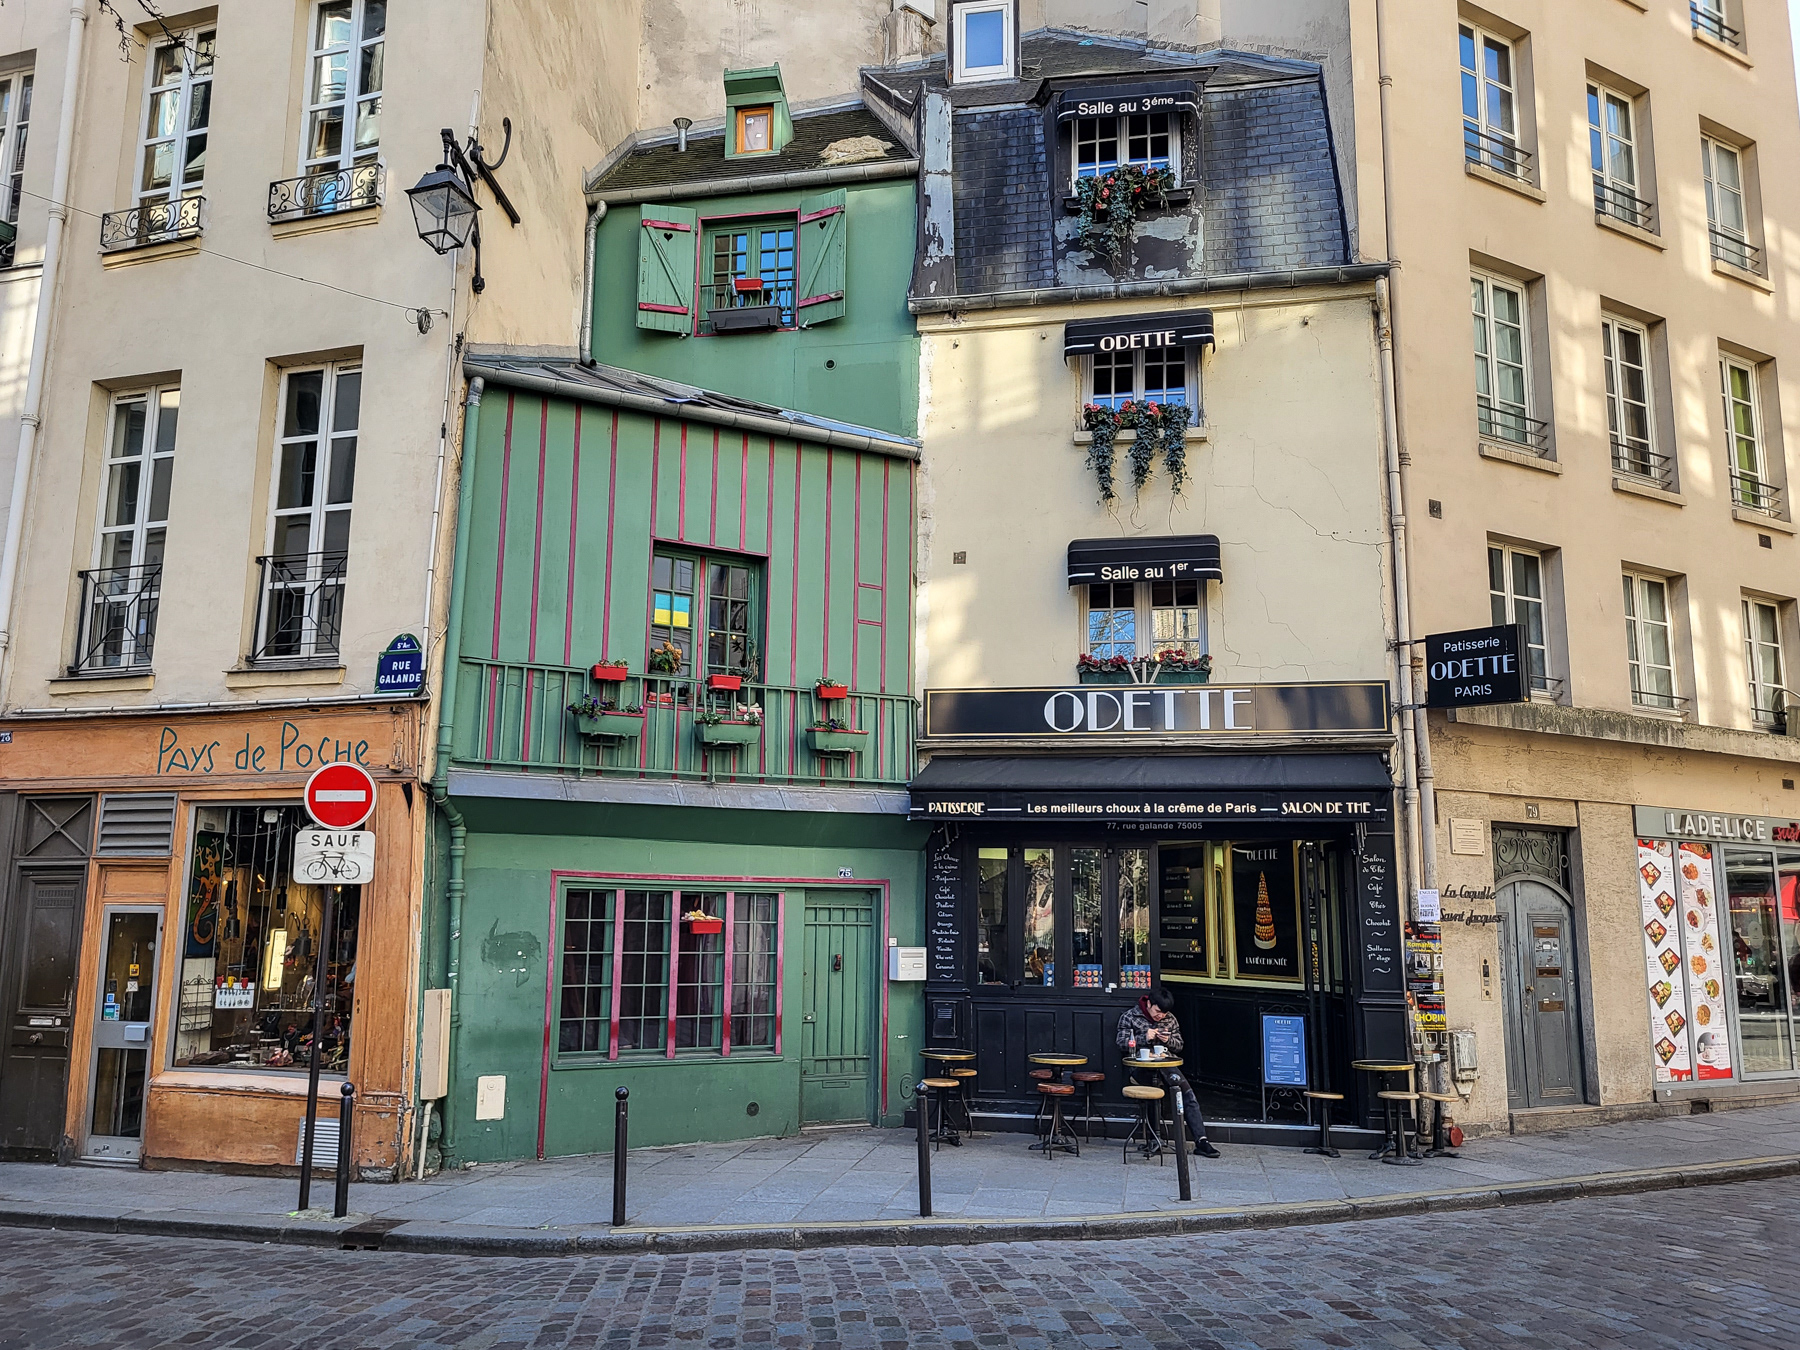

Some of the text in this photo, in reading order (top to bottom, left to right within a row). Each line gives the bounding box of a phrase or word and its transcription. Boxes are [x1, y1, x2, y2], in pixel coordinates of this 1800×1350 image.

[1078, 102, 1113, 115] Salle
[1119, 102, 1137, 113] au
[1100, 330, 1176, 351] ODETTE
[1101, 562, 1189, 580] Salle au 1er
[1443, 636, 1500, 653] Patisserie
[392, 661, 411, 671] RUE
[1430, 653, 1516, 680] ODETTE
[379, 673, 421, 684] GALANDE
[1454, 683, 1492, 697] PARIS
[1043, 689, 1253, 733] ODETTE
[235, 732, 266, 772] de
[928, 802, 985, 816] PATISSERIE
[1027, 803, 1048, 813] Les
[1050, 803, 1103, 813] meilleurs
[1106, 803, 1141, 813] choux
[1143, 802, 1151, 813] à
[1154, 803, 1165, 813] la
[1207, 803, 1222, 813] de
[1225, 803, 1257, 813] Paris
[1281, 802, 1323, 815] SALON
[1326, 802, 1343, 813] DE
[1527, 806, 1538, 818] 79
[1106, 822, 1120, 830] 77,
[1139, 822, 1174, 831] galande
[1177, 822, 1203, 830] 75005
[1667, 813, 1767, 840] LADELICE
[311, 834, 361, 847] SAUF
[1362, 854, 1386, 863] Salon
[839, 869, 852, 878] 75
[1367, 883, 1383, 894] Café
[1441, 884, 1497, 902] La Coquille
[1365, 918, 1391, 926] Chocolat
[1440, 907, 1465, 922] Saint
[1465, 910, 1503, 926] Jacques
[1414, 1013, 1446, 1022] CHOPIN
